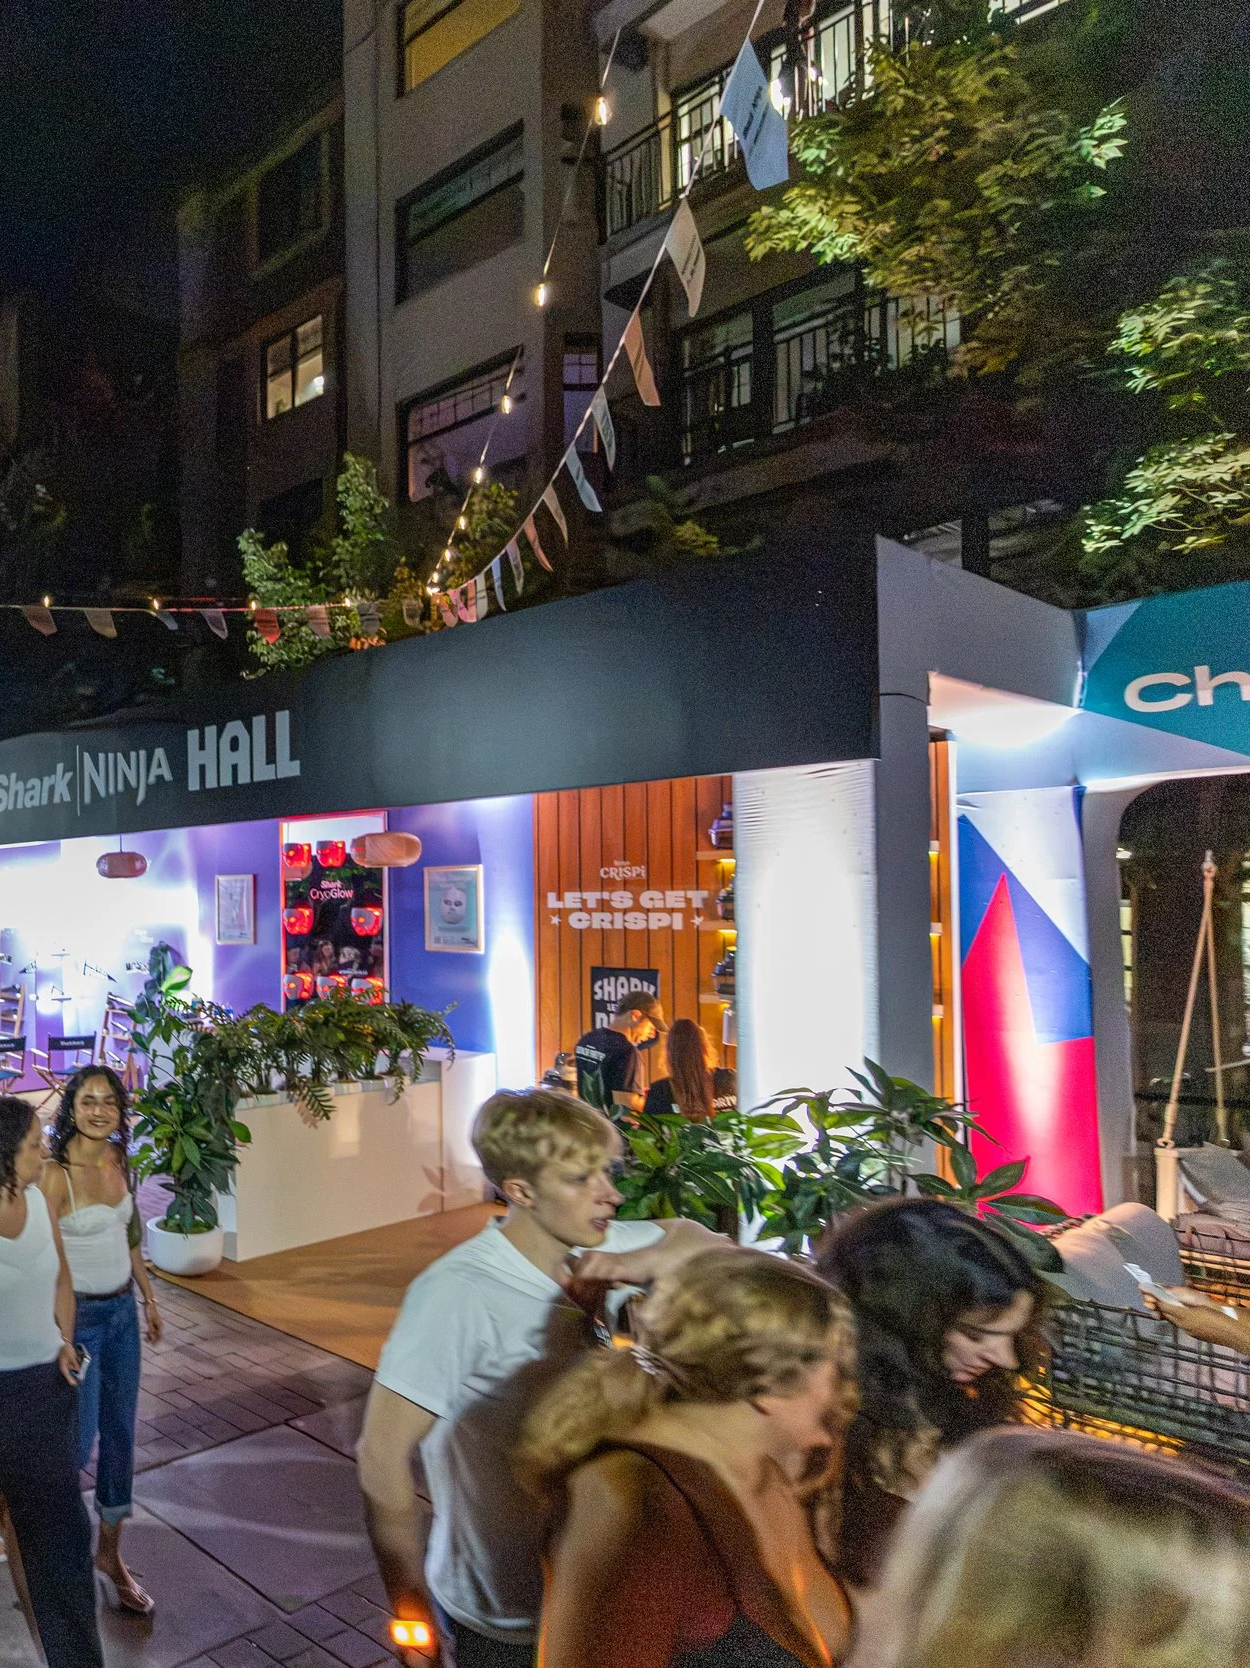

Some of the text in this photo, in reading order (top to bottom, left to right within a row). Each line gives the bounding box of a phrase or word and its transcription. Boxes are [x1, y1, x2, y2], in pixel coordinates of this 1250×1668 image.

[83, 747, 174, 807] NINJA
[187, 709, 301, 792] HALL
[547, 890, 709, 909] LET'S GET
[568, 911, 684, 930] CRISPI
